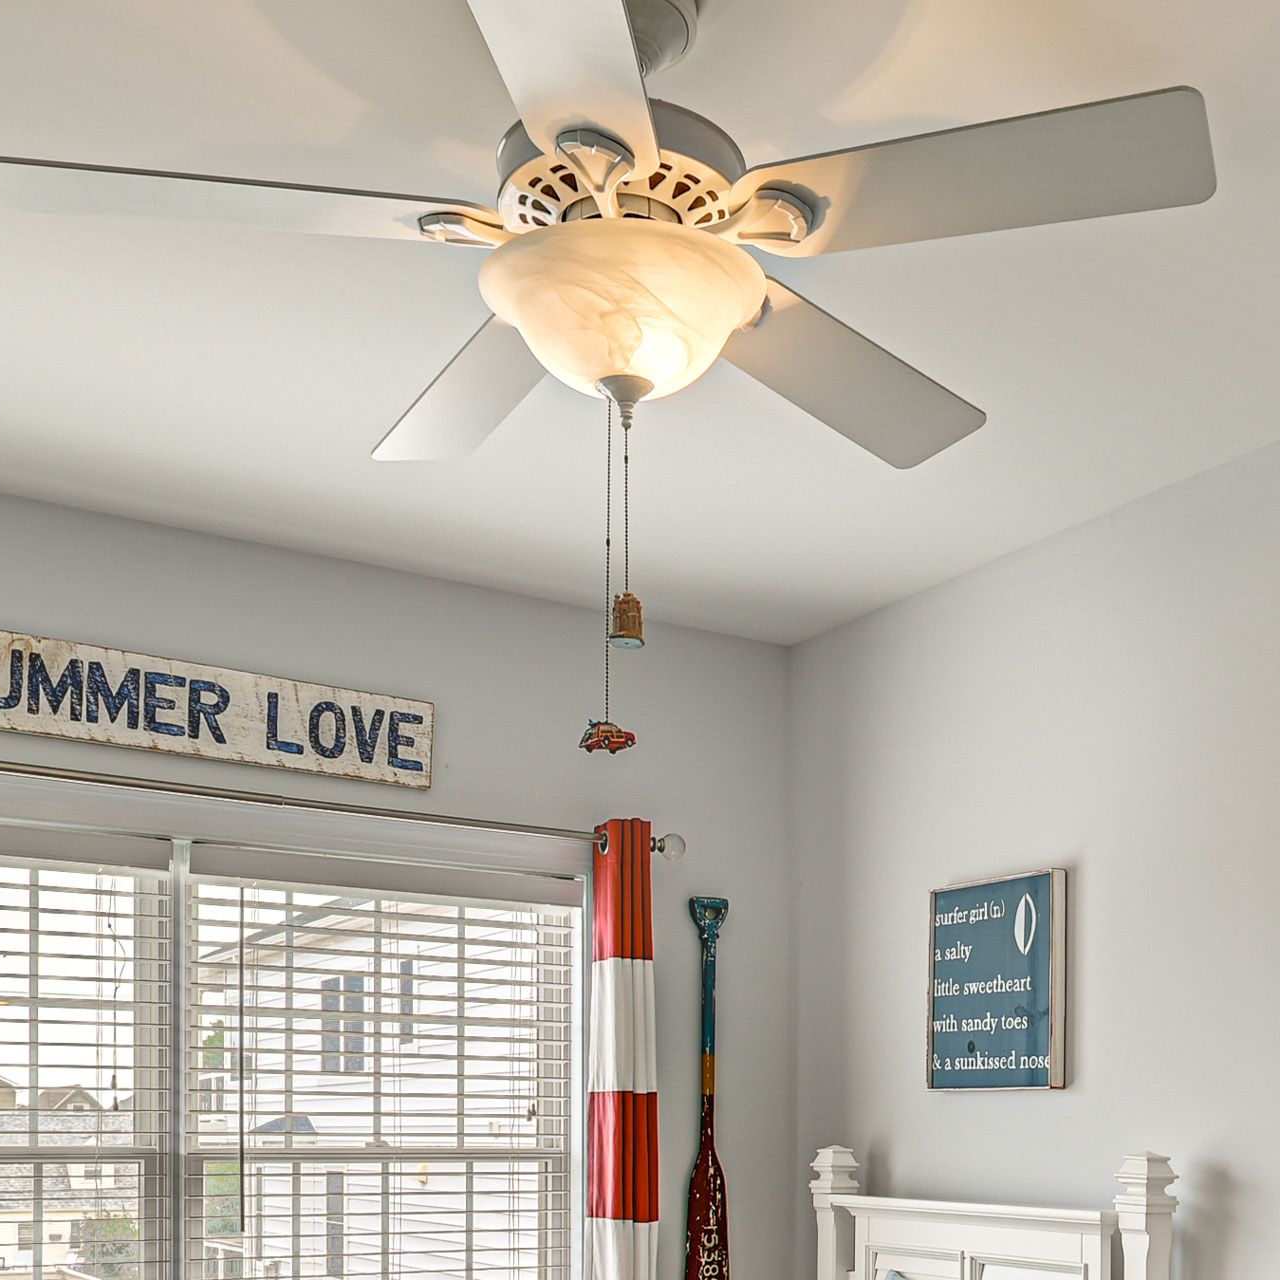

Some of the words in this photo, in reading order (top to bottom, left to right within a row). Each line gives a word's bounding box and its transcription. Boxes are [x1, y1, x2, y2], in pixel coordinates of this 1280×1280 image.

[266, 692, 425, 772] LOVE
[935, 906, 969, 927] surfer
[969, 902, 989, 925] girl
[989, 899, 1006, 919] (n)
[934, 947, 942, 962] a
[944, 940, 973, 963] salty
[934, 978, 960, 997] little
[964, 974, 1032, 995] sweetheart
[933, 1013, 958, 1033] with
[961, 1012, 998, 1035] sandy
[1001, 1015, 1028, 1030] toes
[932, 1053, 942, 1070] &
[944, 1059, 952, 1071] a
[954, 1050, 1016, 1070] sunkissed
